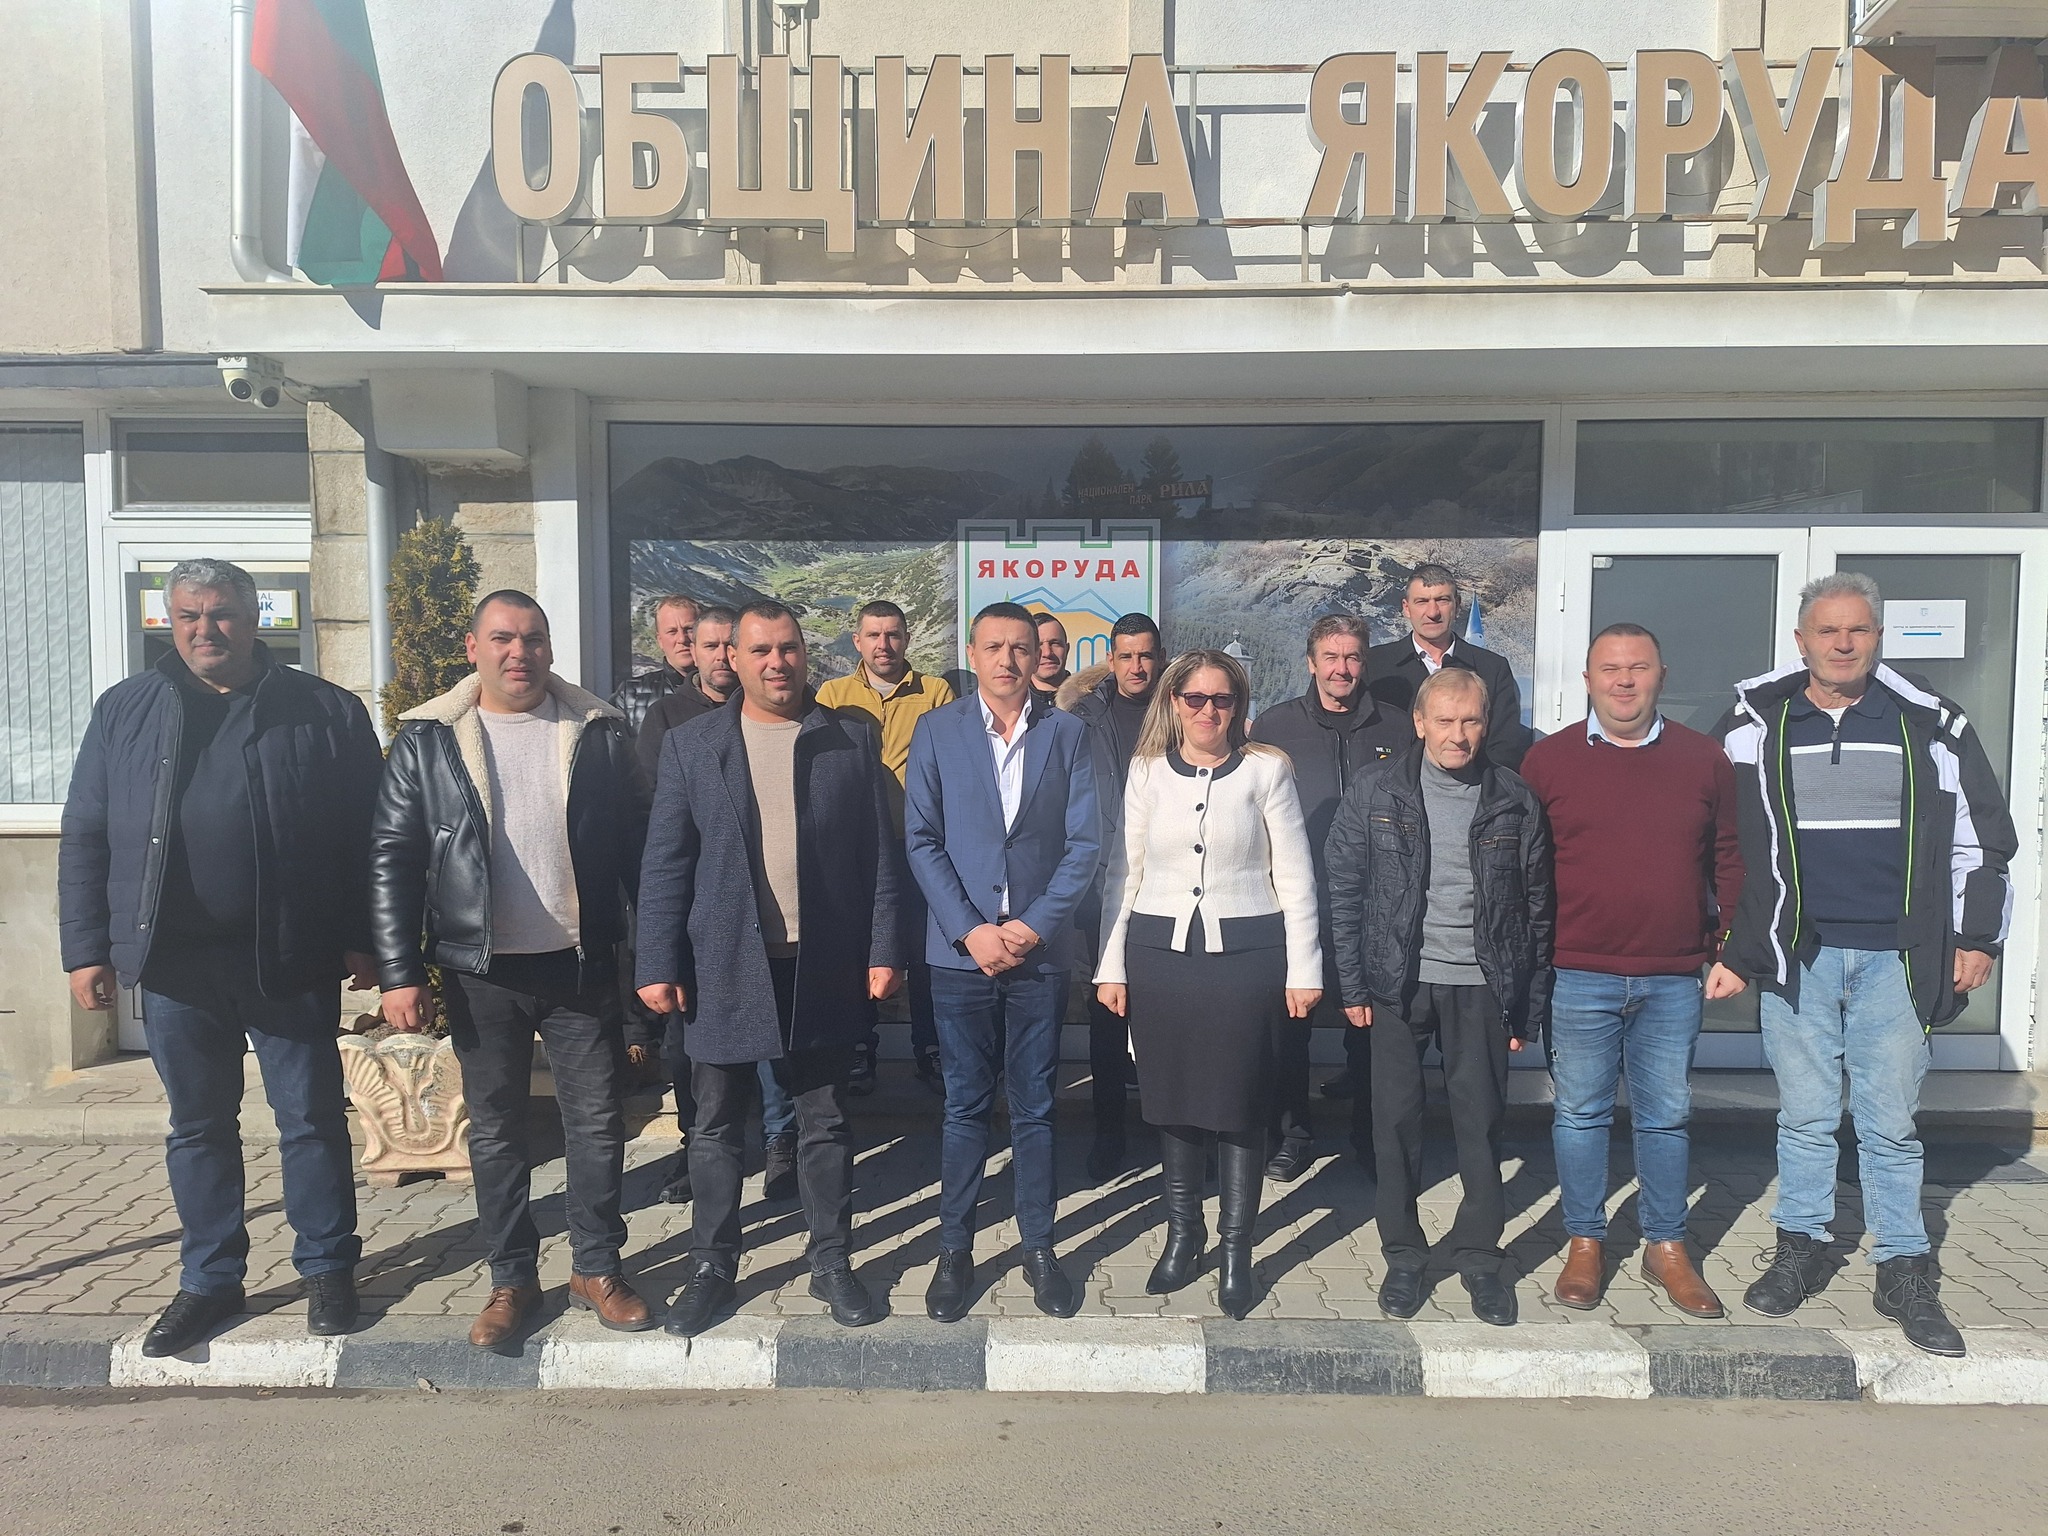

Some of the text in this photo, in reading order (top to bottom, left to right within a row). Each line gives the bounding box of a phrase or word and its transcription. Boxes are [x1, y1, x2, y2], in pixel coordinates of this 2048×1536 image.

[491, 44, 2048, 254] ОБЩИНА ЯКОРУДА
[1078, 483, 1135, 498] НАЦИОНАЛЕН
[1160, 480, 1209, 498] РИЛА
[1129, 494, 1152, 505] ПАРК
[977, 559, 1141, 582] ЯКОРУДА
